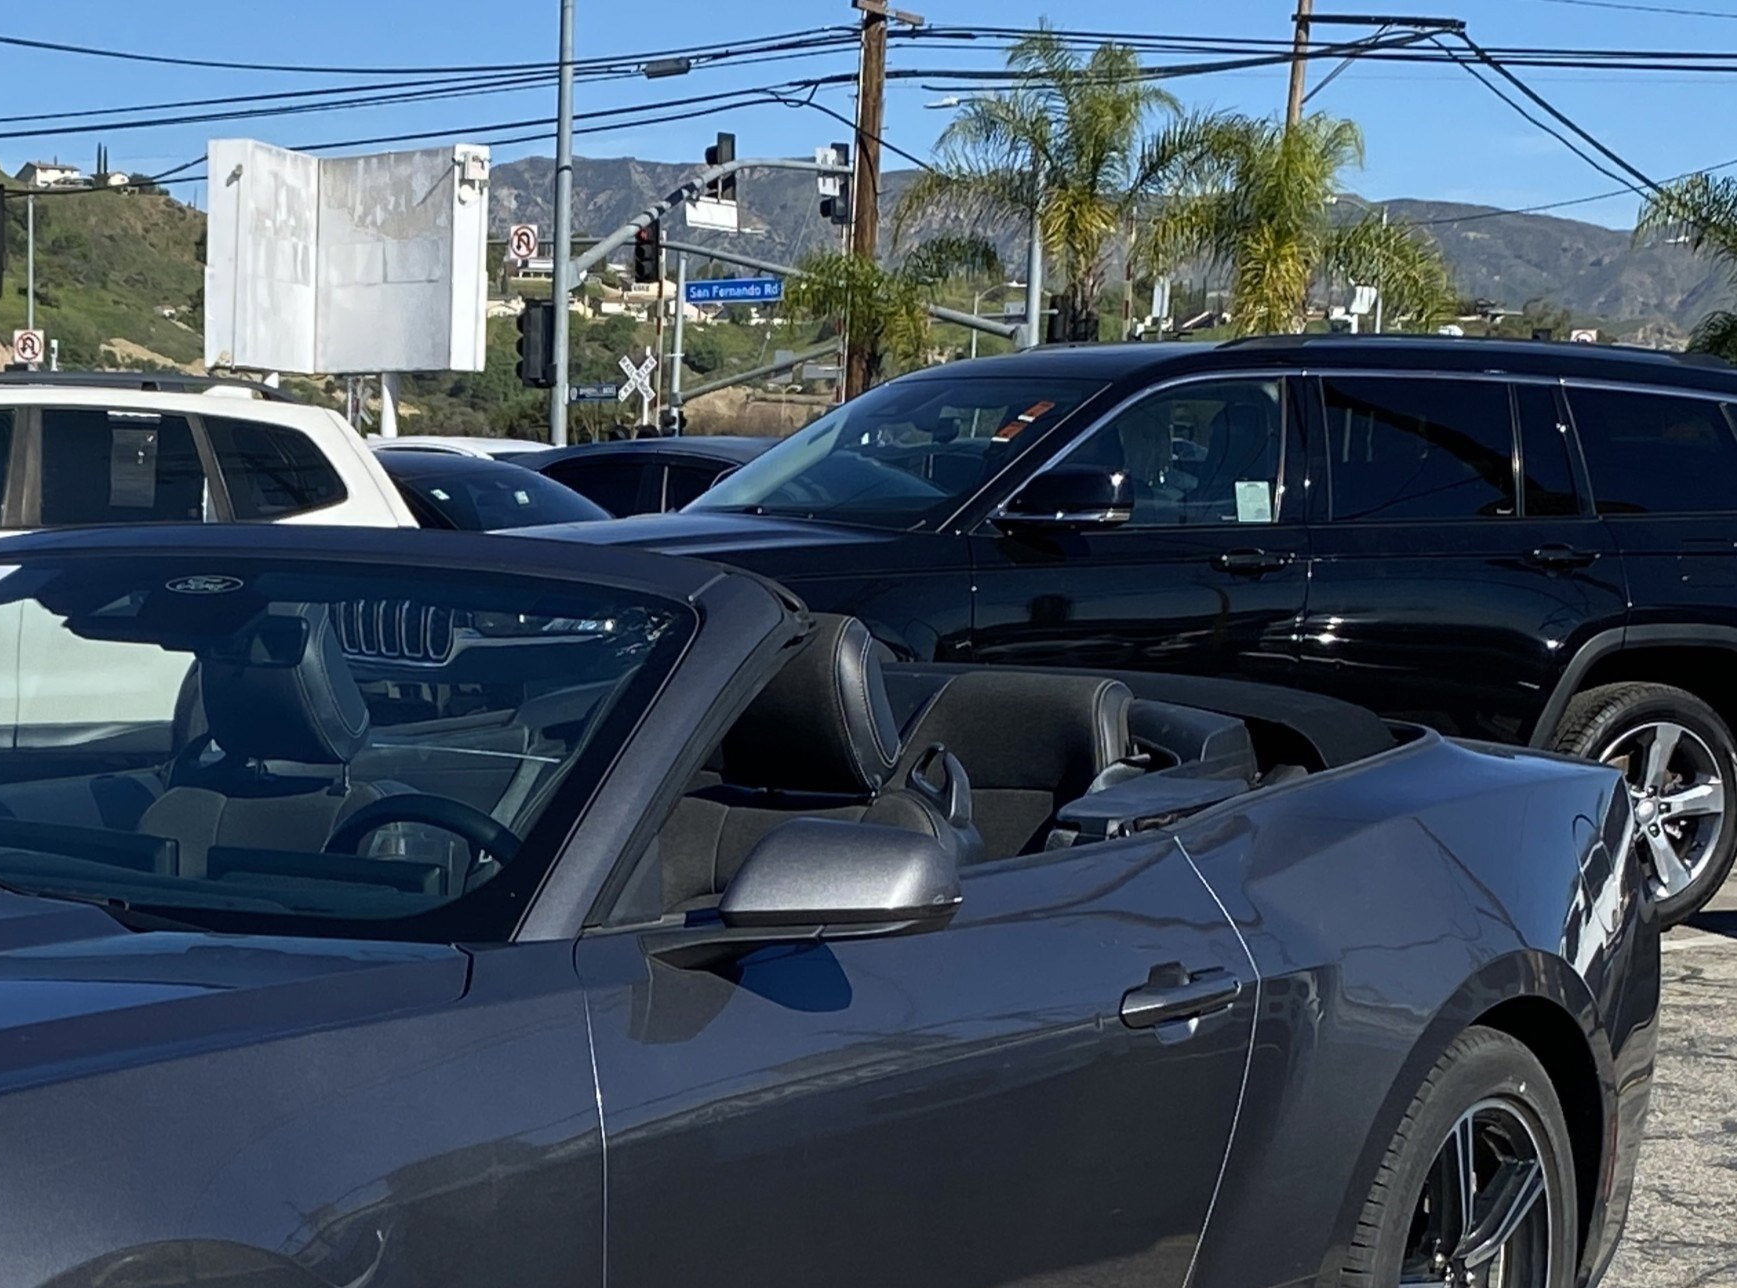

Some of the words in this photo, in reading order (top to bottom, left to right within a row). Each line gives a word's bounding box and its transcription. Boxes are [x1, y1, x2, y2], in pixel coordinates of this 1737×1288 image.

[689, 286, 710, 299] San
[711, 284, 762, 298] Fernando
[764, 283, 779, 295] Rd
